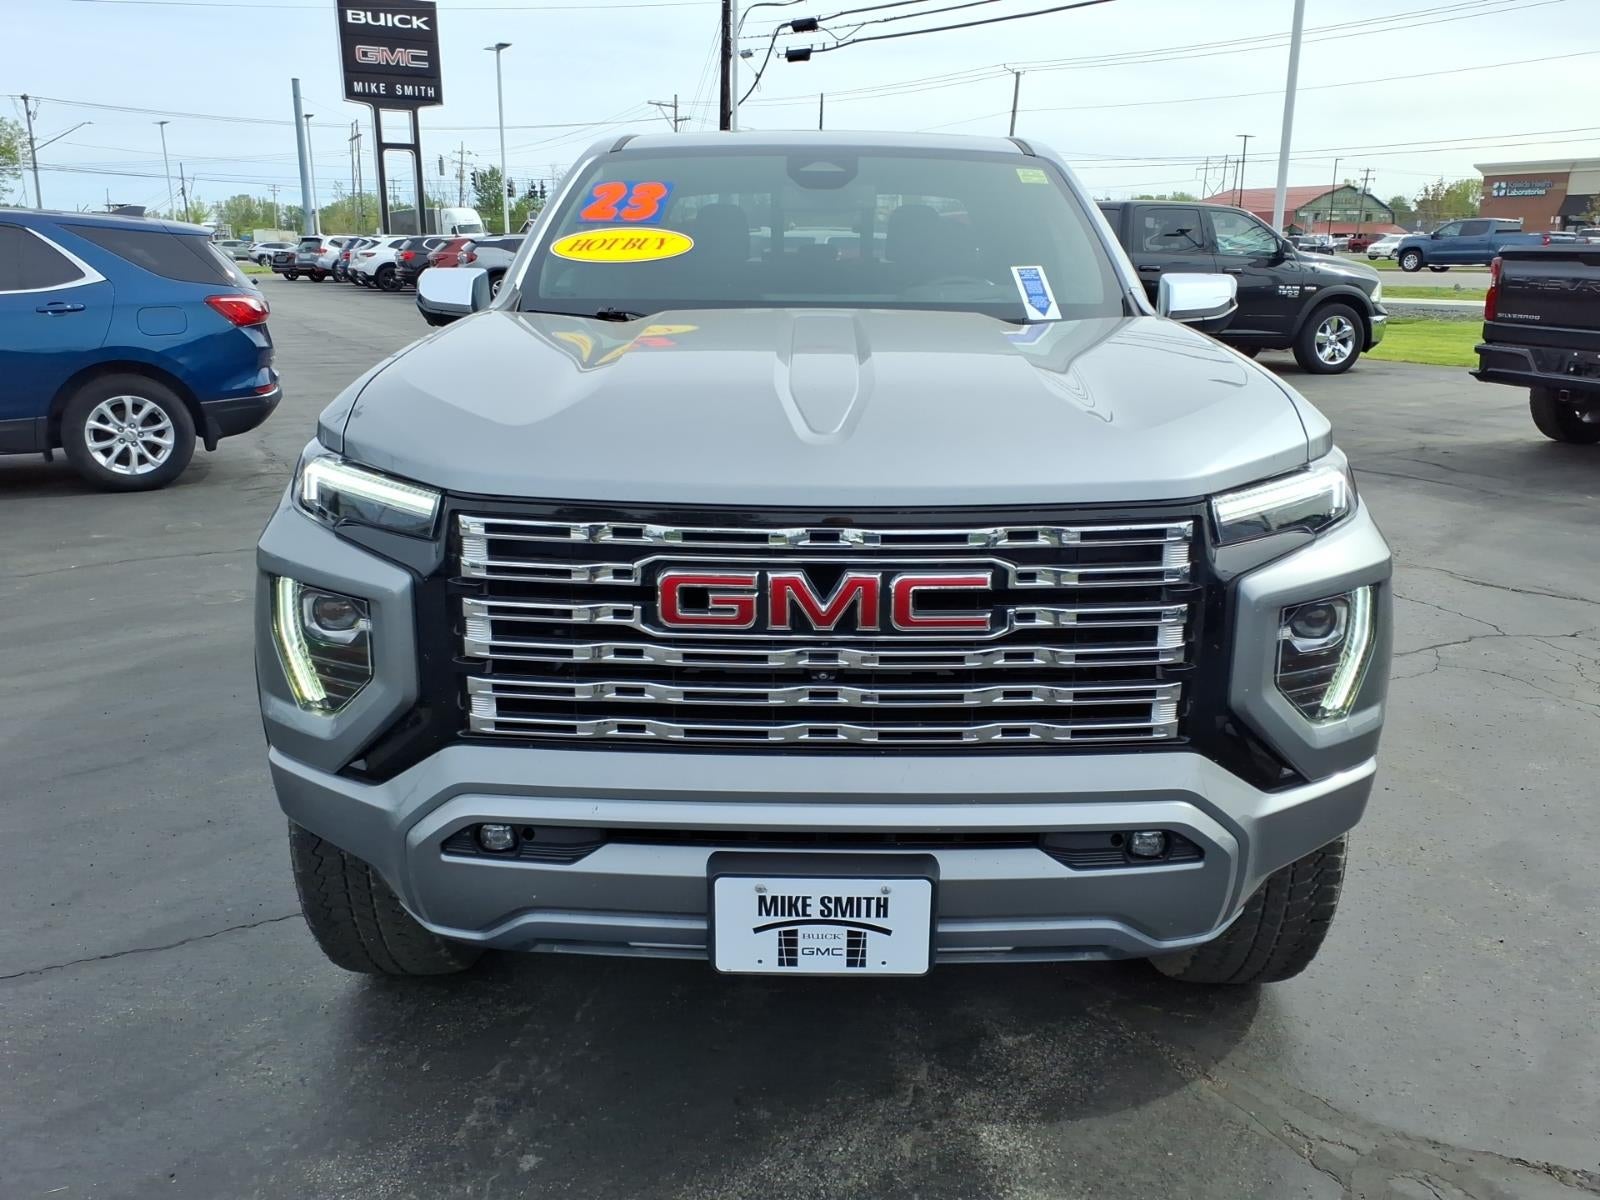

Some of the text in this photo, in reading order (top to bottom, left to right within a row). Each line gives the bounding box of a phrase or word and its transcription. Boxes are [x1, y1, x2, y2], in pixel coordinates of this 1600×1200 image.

[346, 9, 431, 30] BUICK
[355, 45, 429, 68] GMC
[353, 81, 435, 97] MIKE SMITH
[580, 181, 668, 222] 23
[567, 238, 673, 251] HOT BUY
[1497, 312, 1541, 320] SILVERADO
[656, 570, 993, 632] GMC
[757, 895, 889, 918] MIKE SMITH
[802, 932, 843, 940] BUICK
[801, 947, 844, 957] GMC
